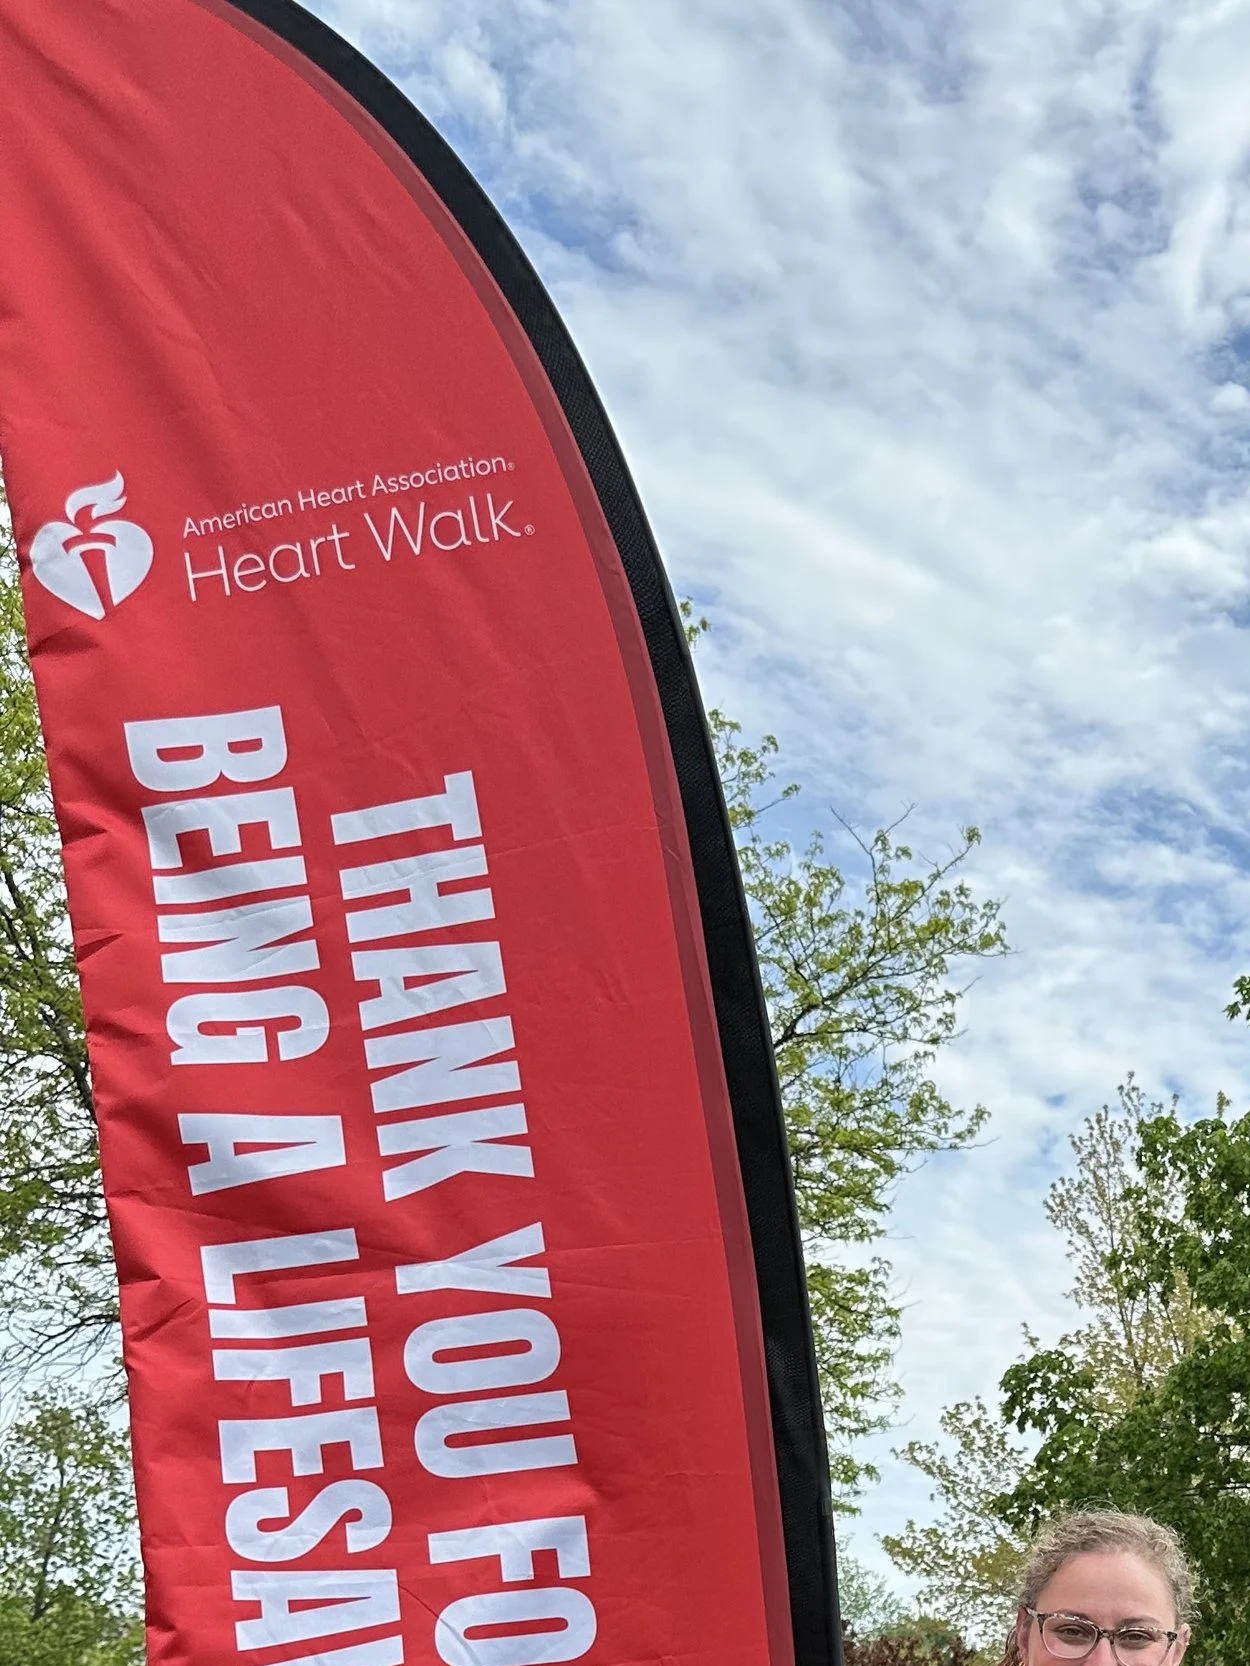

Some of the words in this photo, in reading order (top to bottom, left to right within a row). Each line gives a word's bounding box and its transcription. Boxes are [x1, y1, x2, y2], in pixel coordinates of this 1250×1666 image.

[183, 499, 293, 538] American
[298, 480, 366, 511] Heart
[184, 524, 356, 602] Heart
[124, 705, 331, 1066] BEING
[331, 770, 534, 1202] THANK
[178, 1113, 347, 1197] A
[395, 1222, 578, 1479] YOU
